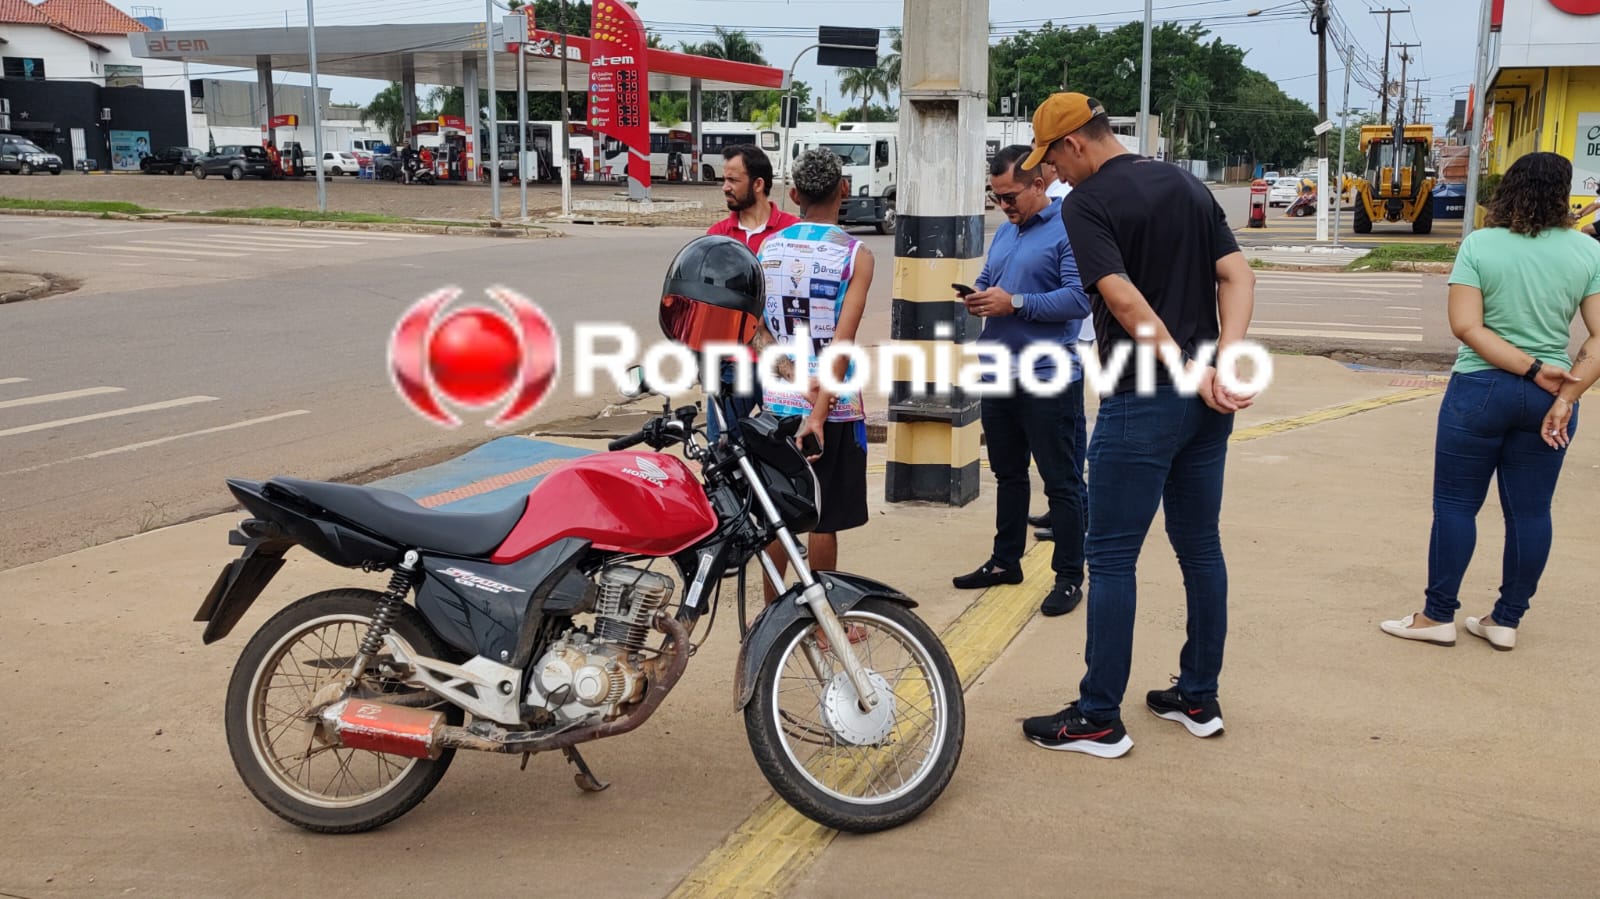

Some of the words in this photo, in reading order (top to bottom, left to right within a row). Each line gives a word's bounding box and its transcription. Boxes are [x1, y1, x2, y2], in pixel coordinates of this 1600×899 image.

[149, 36, 209, 52] atem
[591, 55, 635, 67] atem
[621, 467, 664, 488] HONDA
